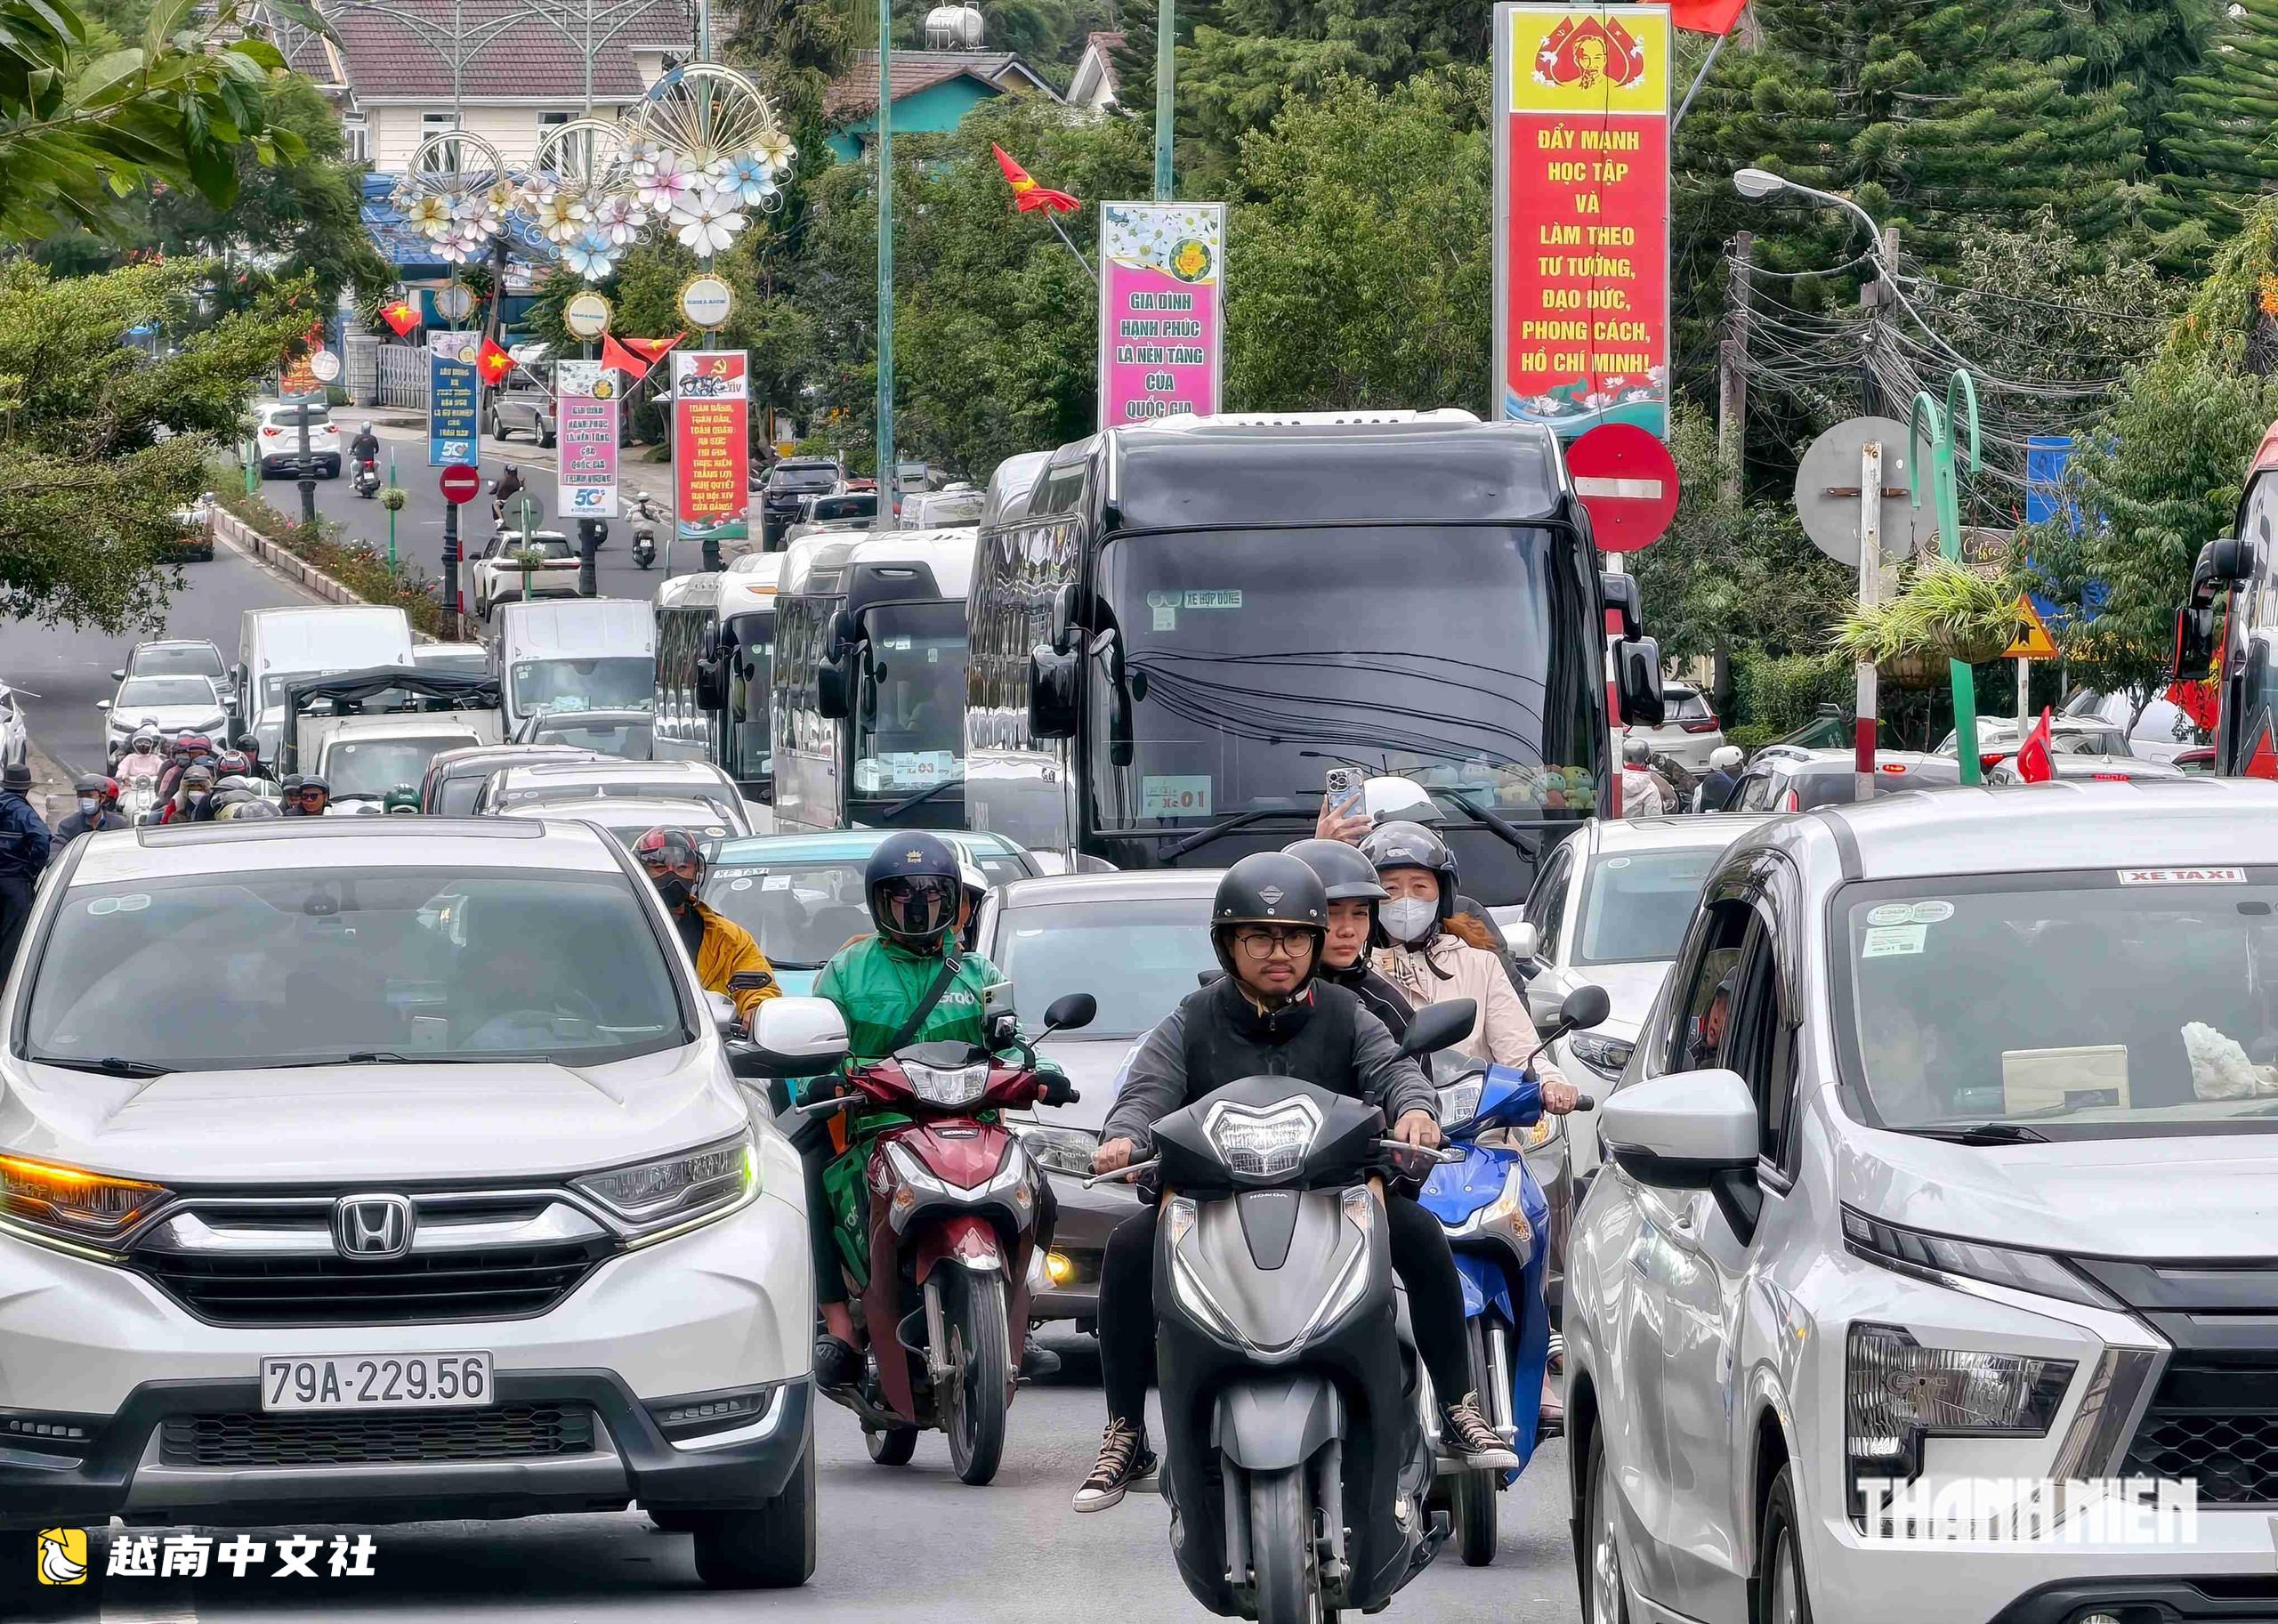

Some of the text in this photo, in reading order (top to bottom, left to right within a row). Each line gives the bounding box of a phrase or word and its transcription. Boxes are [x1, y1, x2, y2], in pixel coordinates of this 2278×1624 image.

[1537, 122, 1640, 155] ĐẨY MẠNH
[1547, 158, 1629, 186] HỌC TẬP
[1574, 190, 1601, 214] VÀ
[1539, 221, 1636, 246] LÀM THEO
[1538, 251, 1636, 280] TƯ TƯỞNG,
[1129, 292, 1156, 310] GIA
[1541, 286, 1632, 312] ĐẠO ĐỨC,
[1120, 319, 1159, 340] HẠNH
[1522, 317, 1652, 343] PHONG CÁCH,
[1117, 343, 1135, 364] LÀ
[1135, 341, 1164, 364] NỀN
[1521, 345, 1651, 374] HỒ CHÍ MINH!
[1126, 395, 1166, 419] QUỐC
[2131, 870, 2235, 881] XE TAXI
[270, 1356, 484, 1405] 79A-229.56
